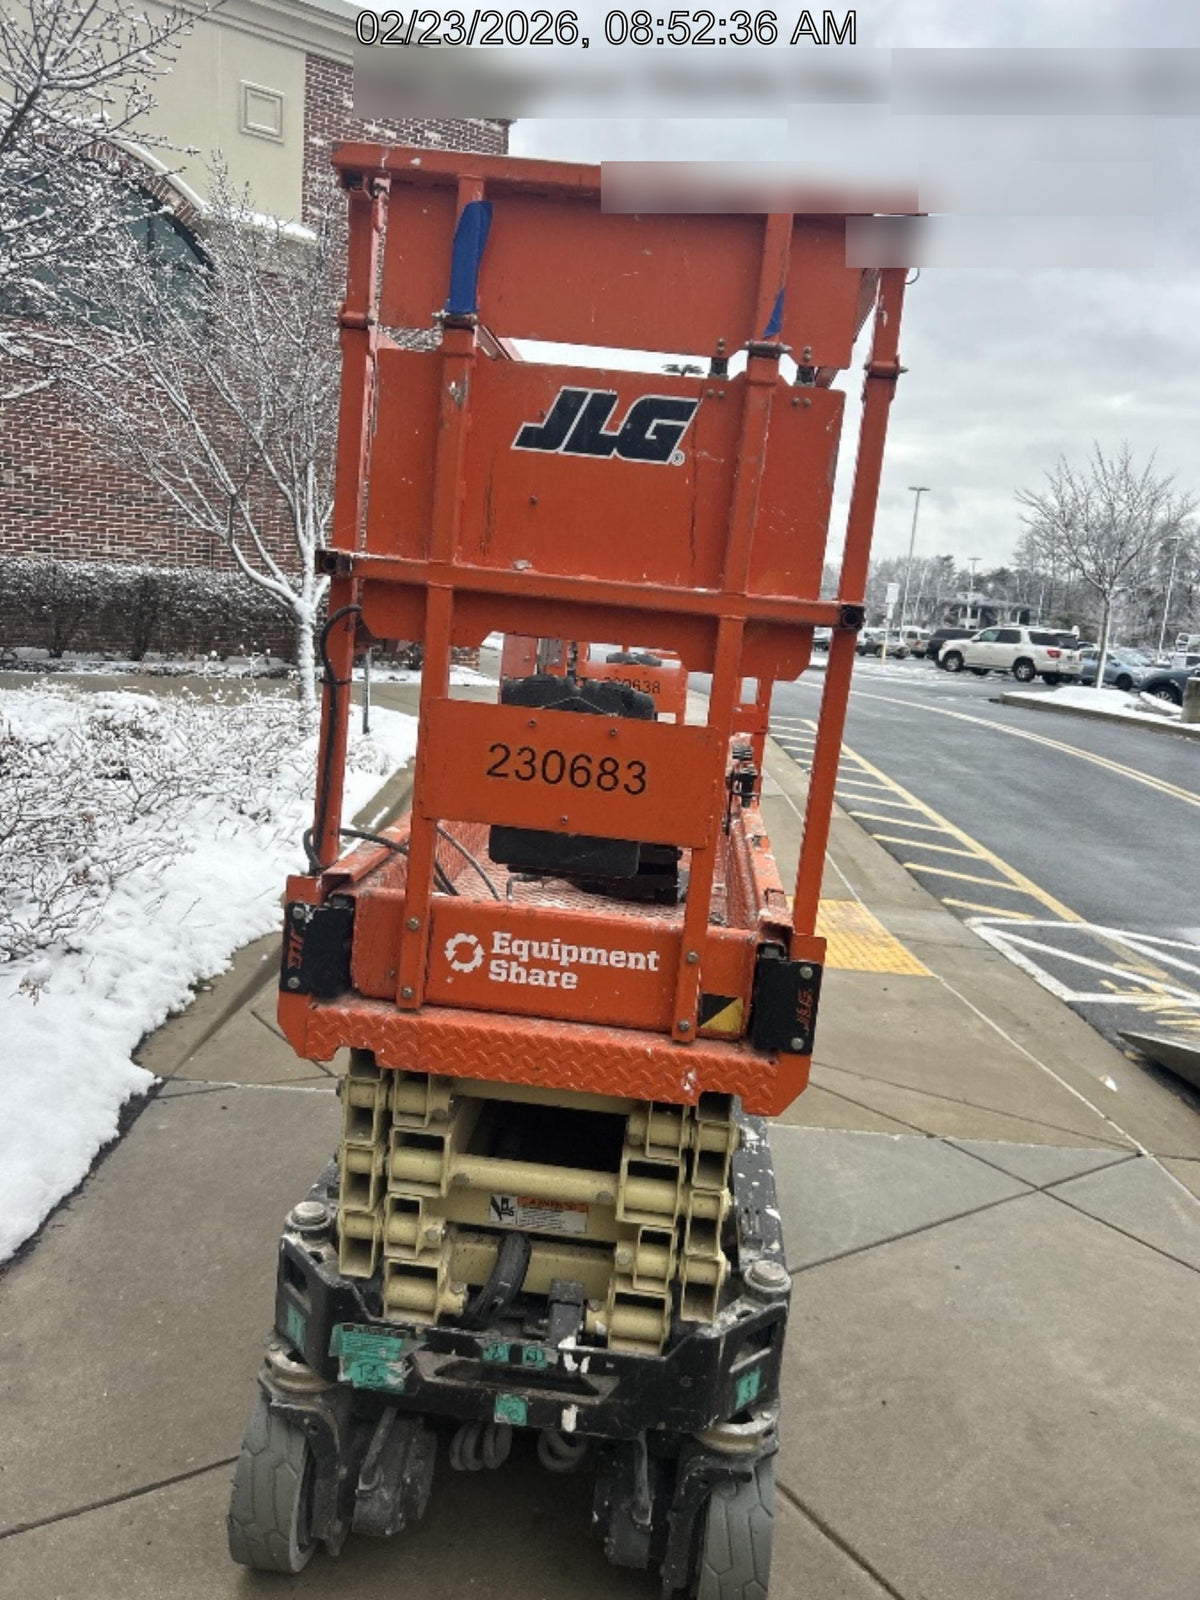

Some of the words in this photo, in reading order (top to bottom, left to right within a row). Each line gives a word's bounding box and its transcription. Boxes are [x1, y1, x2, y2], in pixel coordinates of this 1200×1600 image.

[510, 385, 702, 465] JLG
[486, 743, 647, 795] 230683
[491, 931, 660, 971] Equipment
[488, 960, 578, 989] Share
